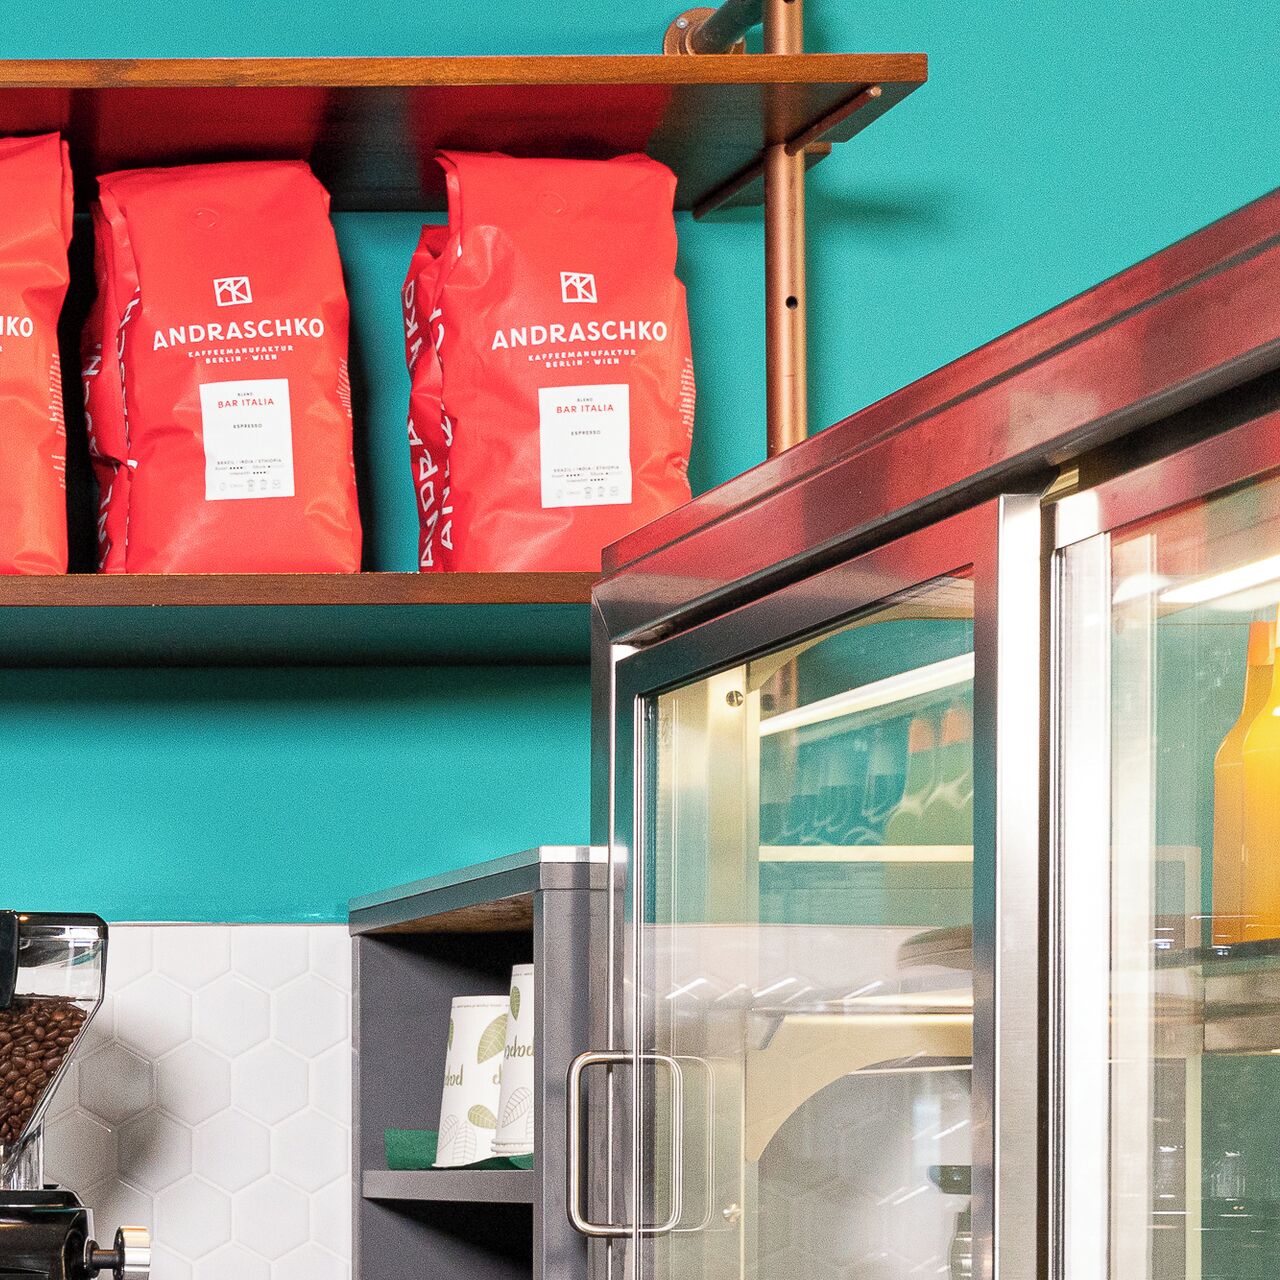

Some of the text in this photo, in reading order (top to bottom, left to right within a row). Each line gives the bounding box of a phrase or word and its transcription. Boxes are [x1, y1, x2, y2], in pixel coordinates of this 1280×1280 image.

[153, 318, 325, 351] ANDRASCHKO
[491, 320, 668, 350] ANDRASCHKO
[188, 345, 294, 358] KAFFEEMANUFAKTUR
[528, 349, 636, 362] KAFFEEMANUFAKTUR
[205, 356, 241, 364] BERLIN
[545, 358, 619, 368] BERLIN WIEN
[218, 398, 275, 409] BAR ITALIA
[556, 404, 614, 414] BAR ITALIA
